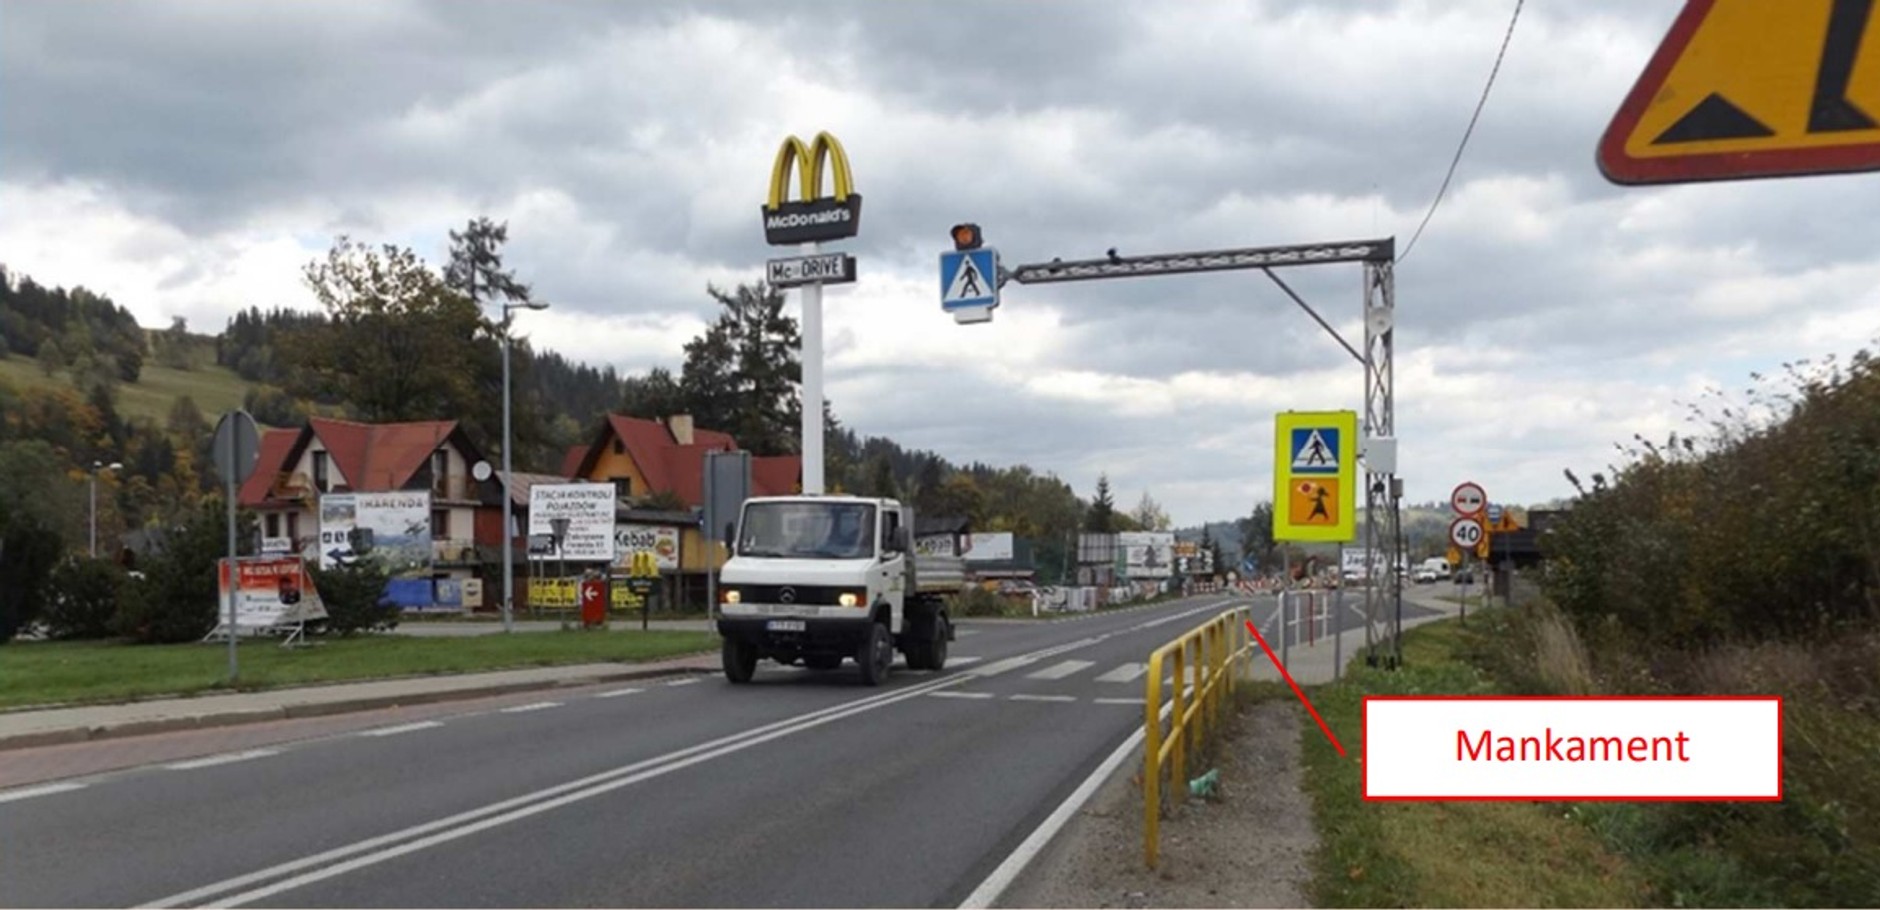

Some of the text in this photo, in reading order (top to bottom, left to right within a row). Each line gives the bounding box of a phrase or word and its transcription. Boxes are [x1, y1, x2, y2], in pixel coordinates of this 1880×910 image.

[766, 208, 851, 229] McDonald's
[801, 256, 840, 278] DRIVE
[614, 529, 655, 548] Kebab
[1456, 526, 1480, 542] 40
